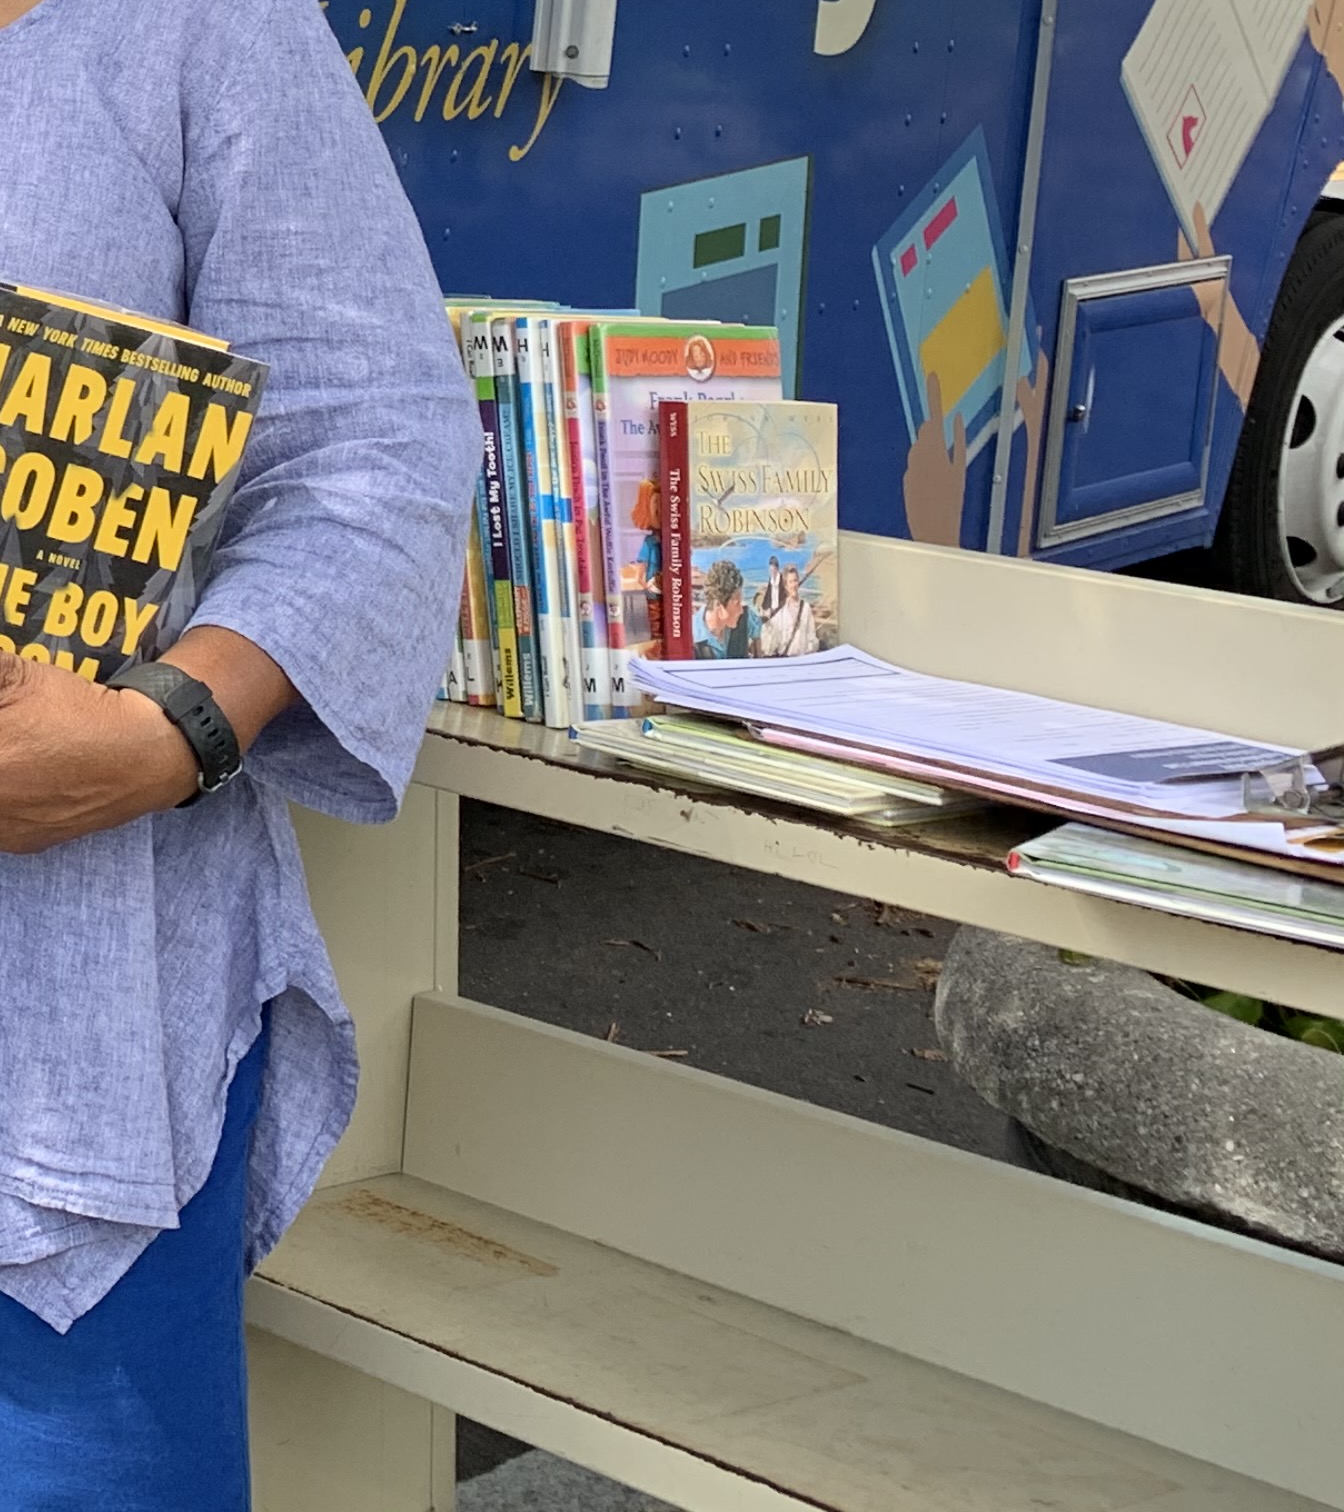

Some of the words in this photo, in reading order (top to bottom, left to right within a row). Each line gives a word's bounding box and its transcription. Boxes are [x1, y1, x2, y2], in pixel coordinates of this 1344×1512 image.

[7, 317, 40, 337] NEW
[43, 326, 79, 349] YORK
[80, 336, 119, 360] TIMES
[120, 348, 199, 383] BESTSELLING
[202, 372, 252, 398] AUTHOR
[517, 338, 529, 353] H
[615, 350, 639, 366] JUDY
[640, 350, 679, 366] MOODY
[719, 351, 737, 366] AND
[740, 350, 780, 366] FRIENDS
[621, 419, 645, 436] The
[670, 412, 678, 437] WYSS
[484, 431, 497, 479] Tooth!
[698, 431, 731, 455] THE
[488, 480, 501, 503] My
[601, 482, 611, 499] The
[669, 469, 681, 492] The
[697, 464, 756, 494] SWISS
[762, 464, 834, 494] FAMILY
[490, 505, 503, 539] Lost
[603, 500, 612, 525] Awful
[669, 494, 681, 531] Swiss
[698, 504, 811, 534] ROBINSON
[35, 549, 44, 561] A
[48, 551, 82, 571] NOVEL
[669, 533, 683, 575] Family
[43, 578, 159, 656] BOY
[672, 577, 683, 638] Robinson
[504, 647, 515, 700] Willems
[522, 652, 534, 707] Willems
[583, 677, 597, 693] M
[611, 676, 625, 693] M
